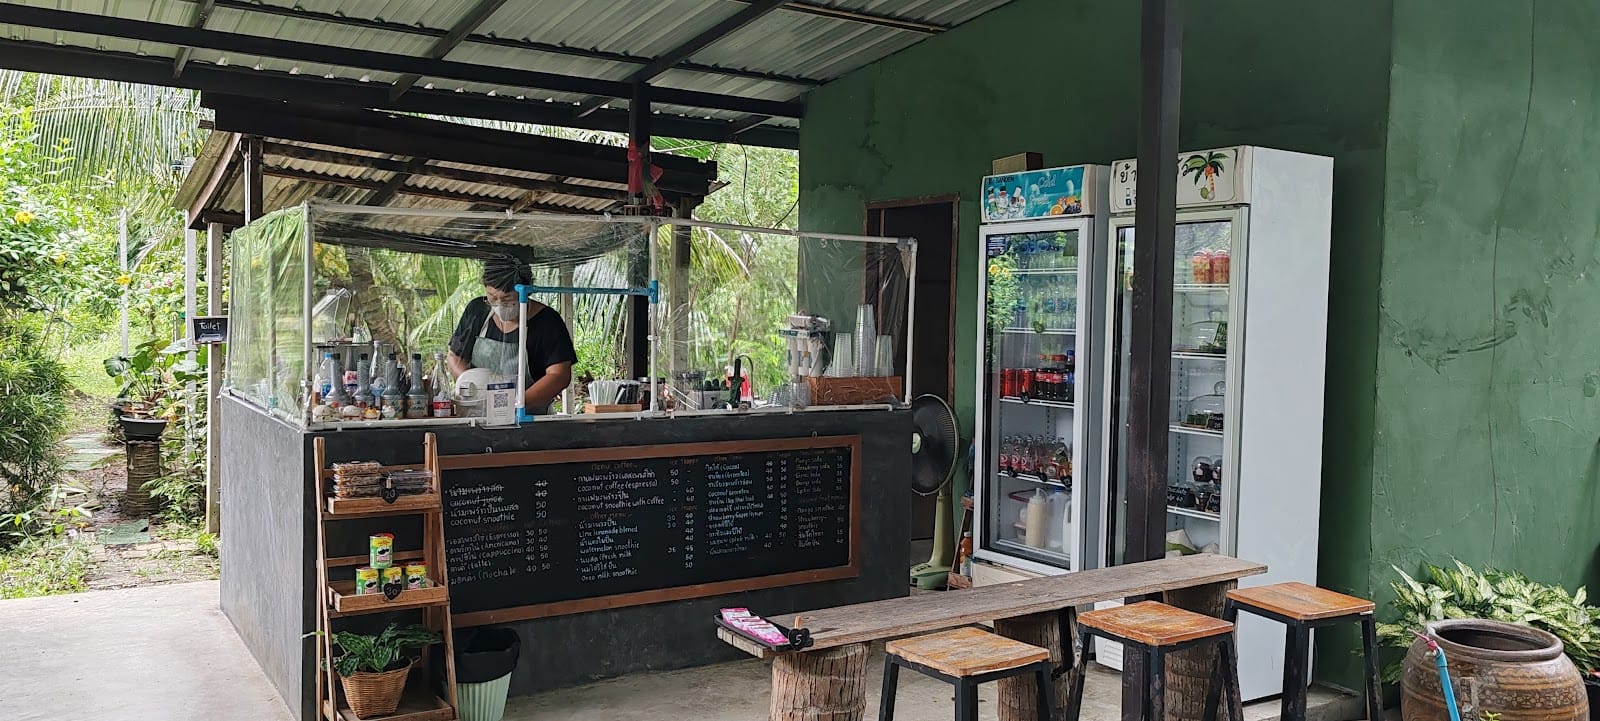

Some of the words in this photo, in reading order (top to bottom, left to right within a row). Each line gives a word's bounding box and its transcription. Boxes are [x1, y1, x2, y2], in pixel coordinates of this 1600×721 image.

[199, 322, 221, 330] Toilet
[578, 483, 603, 493] coconut
[536, 501, 547, 509] 50
[578, 501, 603, 511] coconut
[646, 496, 665, 505] coffee
[450, 515, 481, 526] coconut
[536, 510, 547, 519] 50
[386, 587, 398, 595] 30
[795, 634, 803, 645] 5
